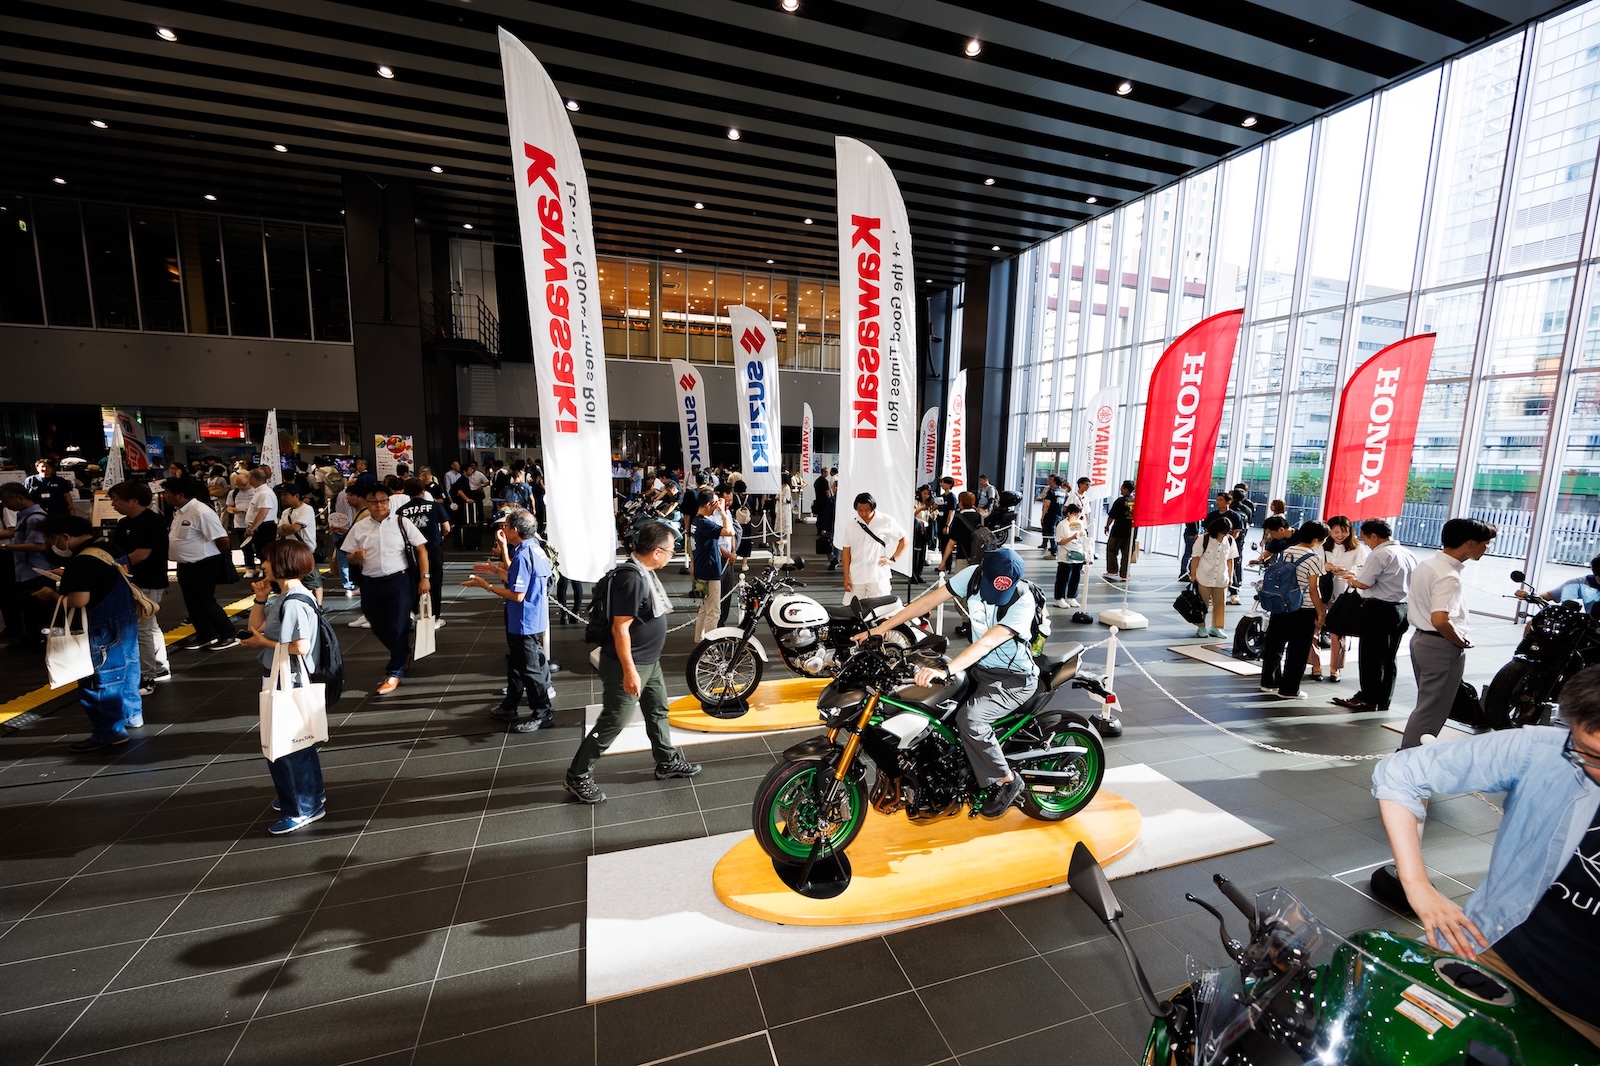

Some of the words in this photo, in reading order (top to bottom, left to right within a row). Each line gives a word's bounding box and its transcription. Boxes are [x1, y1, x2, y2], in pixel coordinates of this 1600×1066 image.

[925, 432, 936, 475] YAMAHA
[951, 418, 964, 488] YAMAHA
[1091, 425, 1111, 487] YAMAHA
[1163, 351, 1207, 504] HONDA
[1355, 366, 1401, 503] HONDA
[402, 504, 433, 516] STAFF
